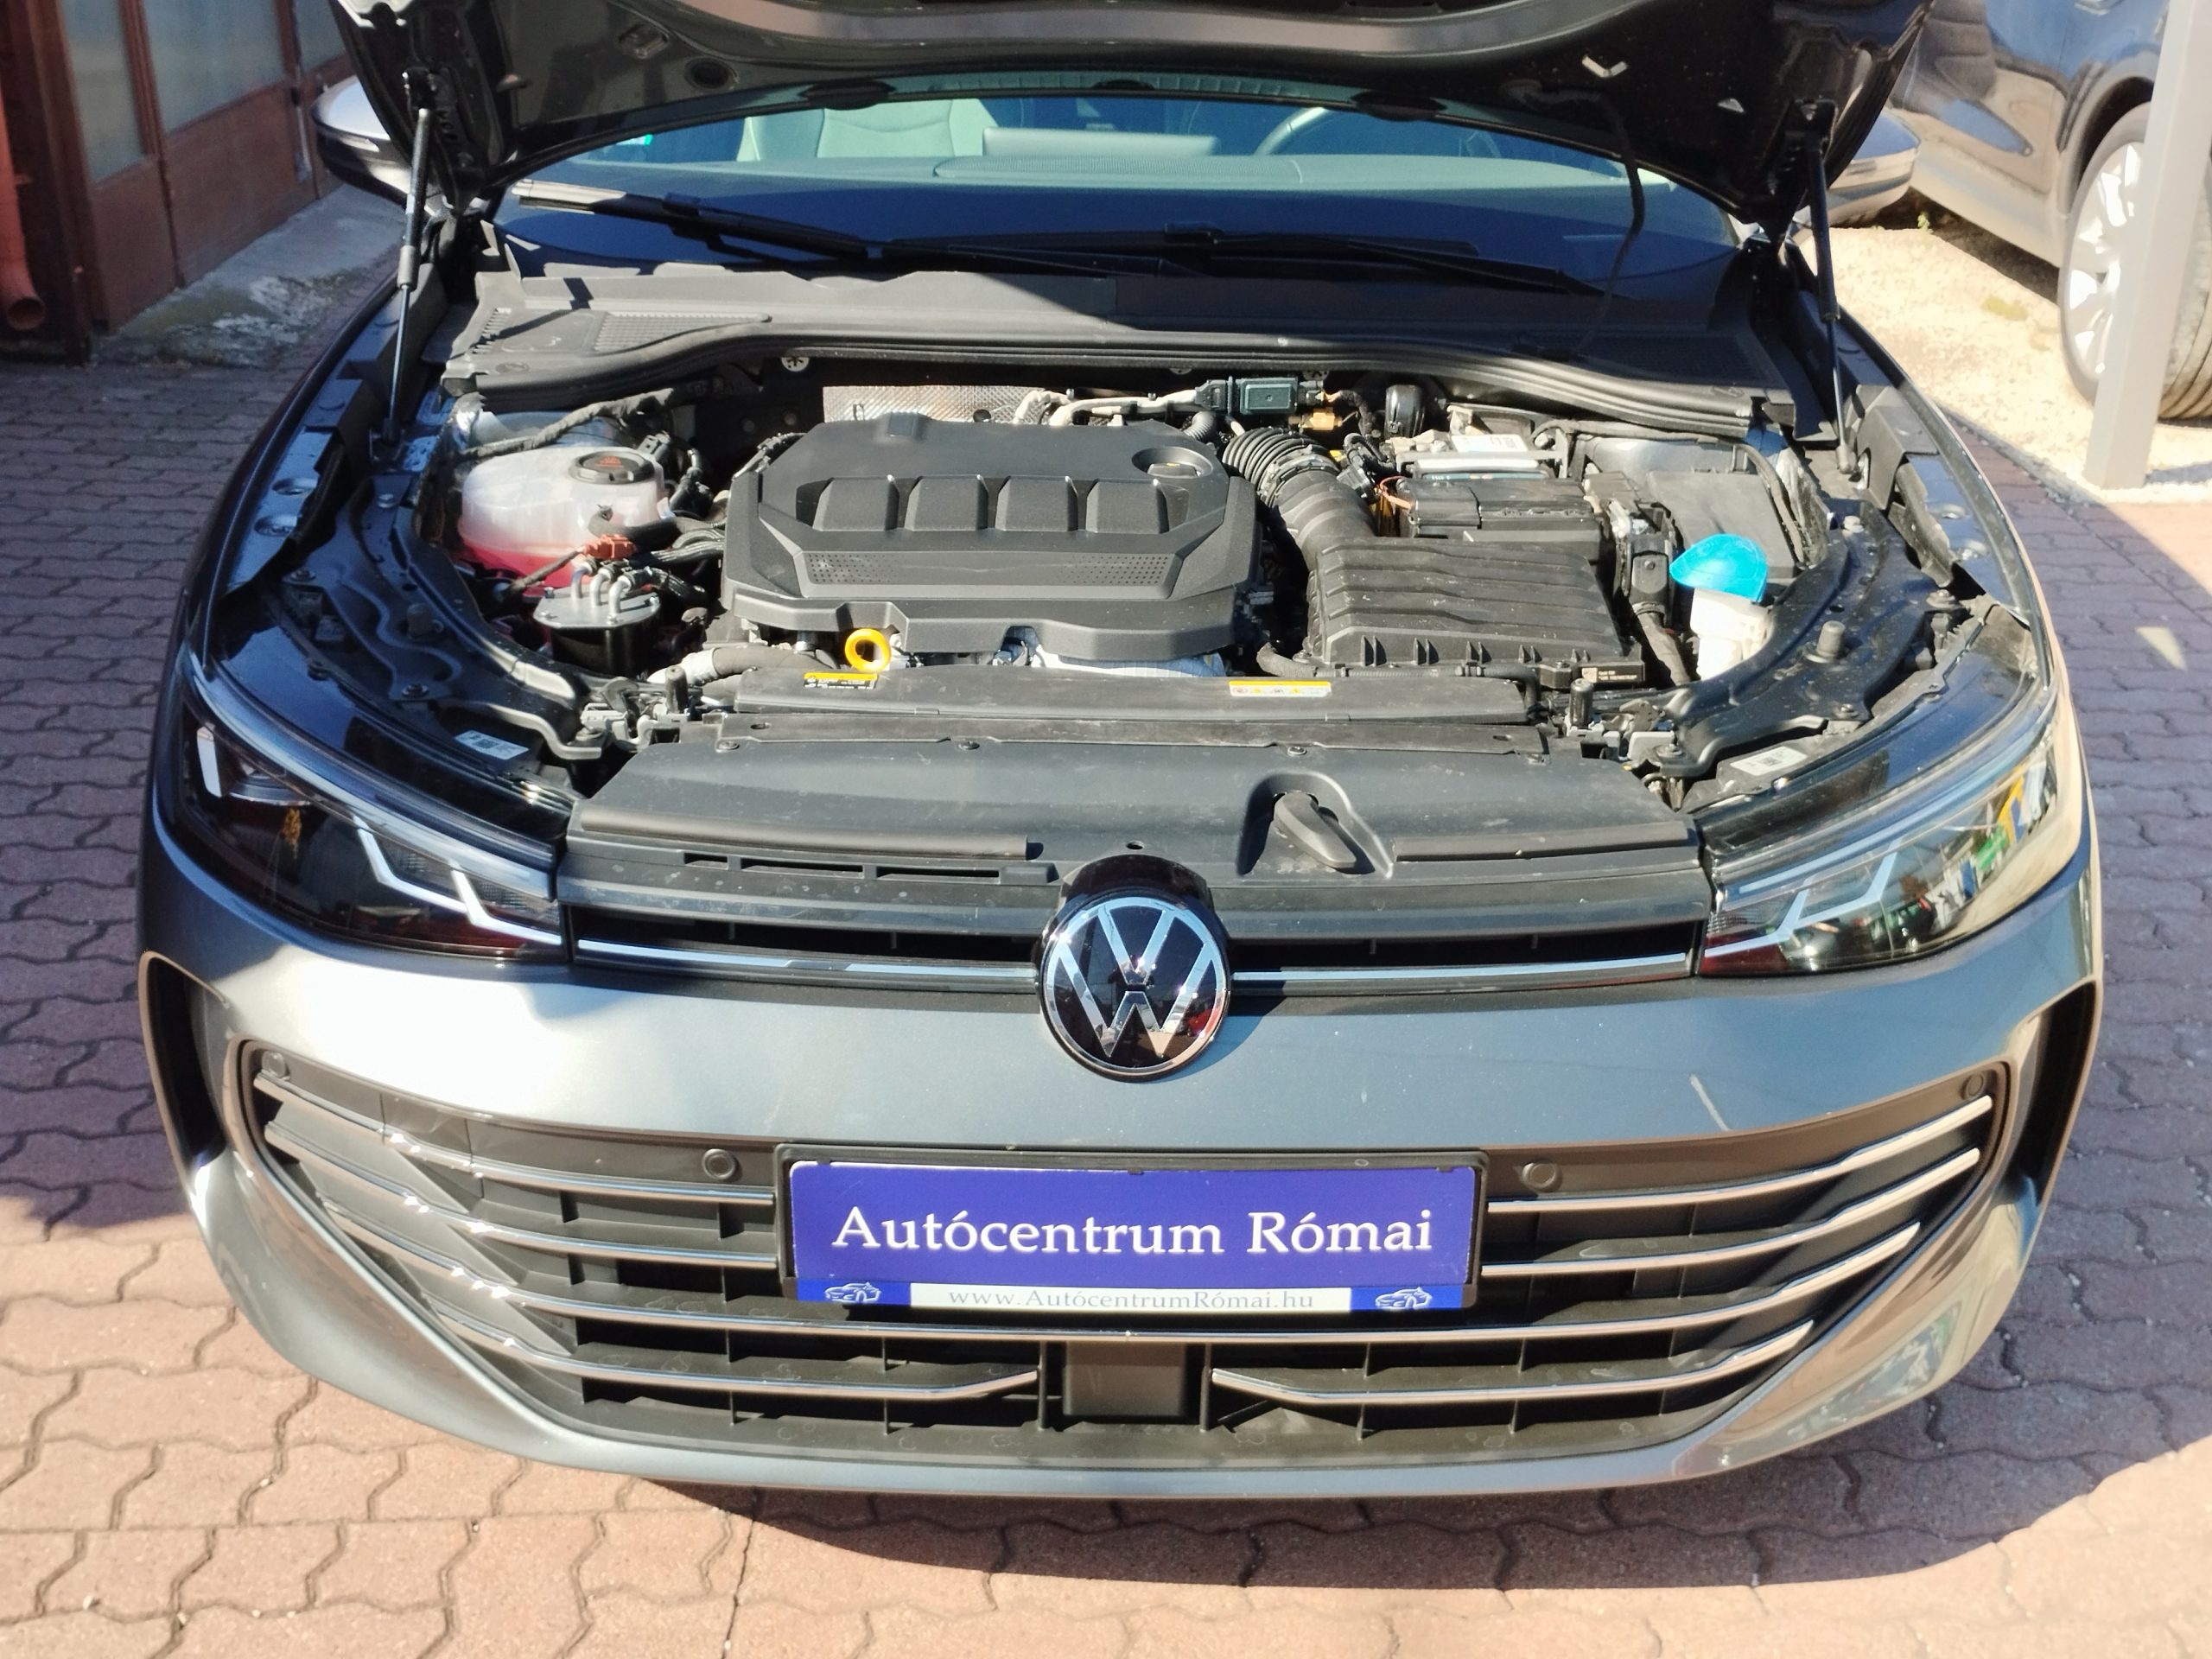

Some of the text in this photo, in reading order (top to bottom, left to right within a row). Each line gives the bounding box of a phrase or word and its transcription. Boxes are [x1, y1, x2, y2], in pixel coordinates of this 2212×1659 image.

[1052, 906, 1217, 1058] VW
[831, 1206, 1433, 1254] Autócentrum Római
[949, 1289, 1313, 1309] www.AutócentrumRómai.hu
